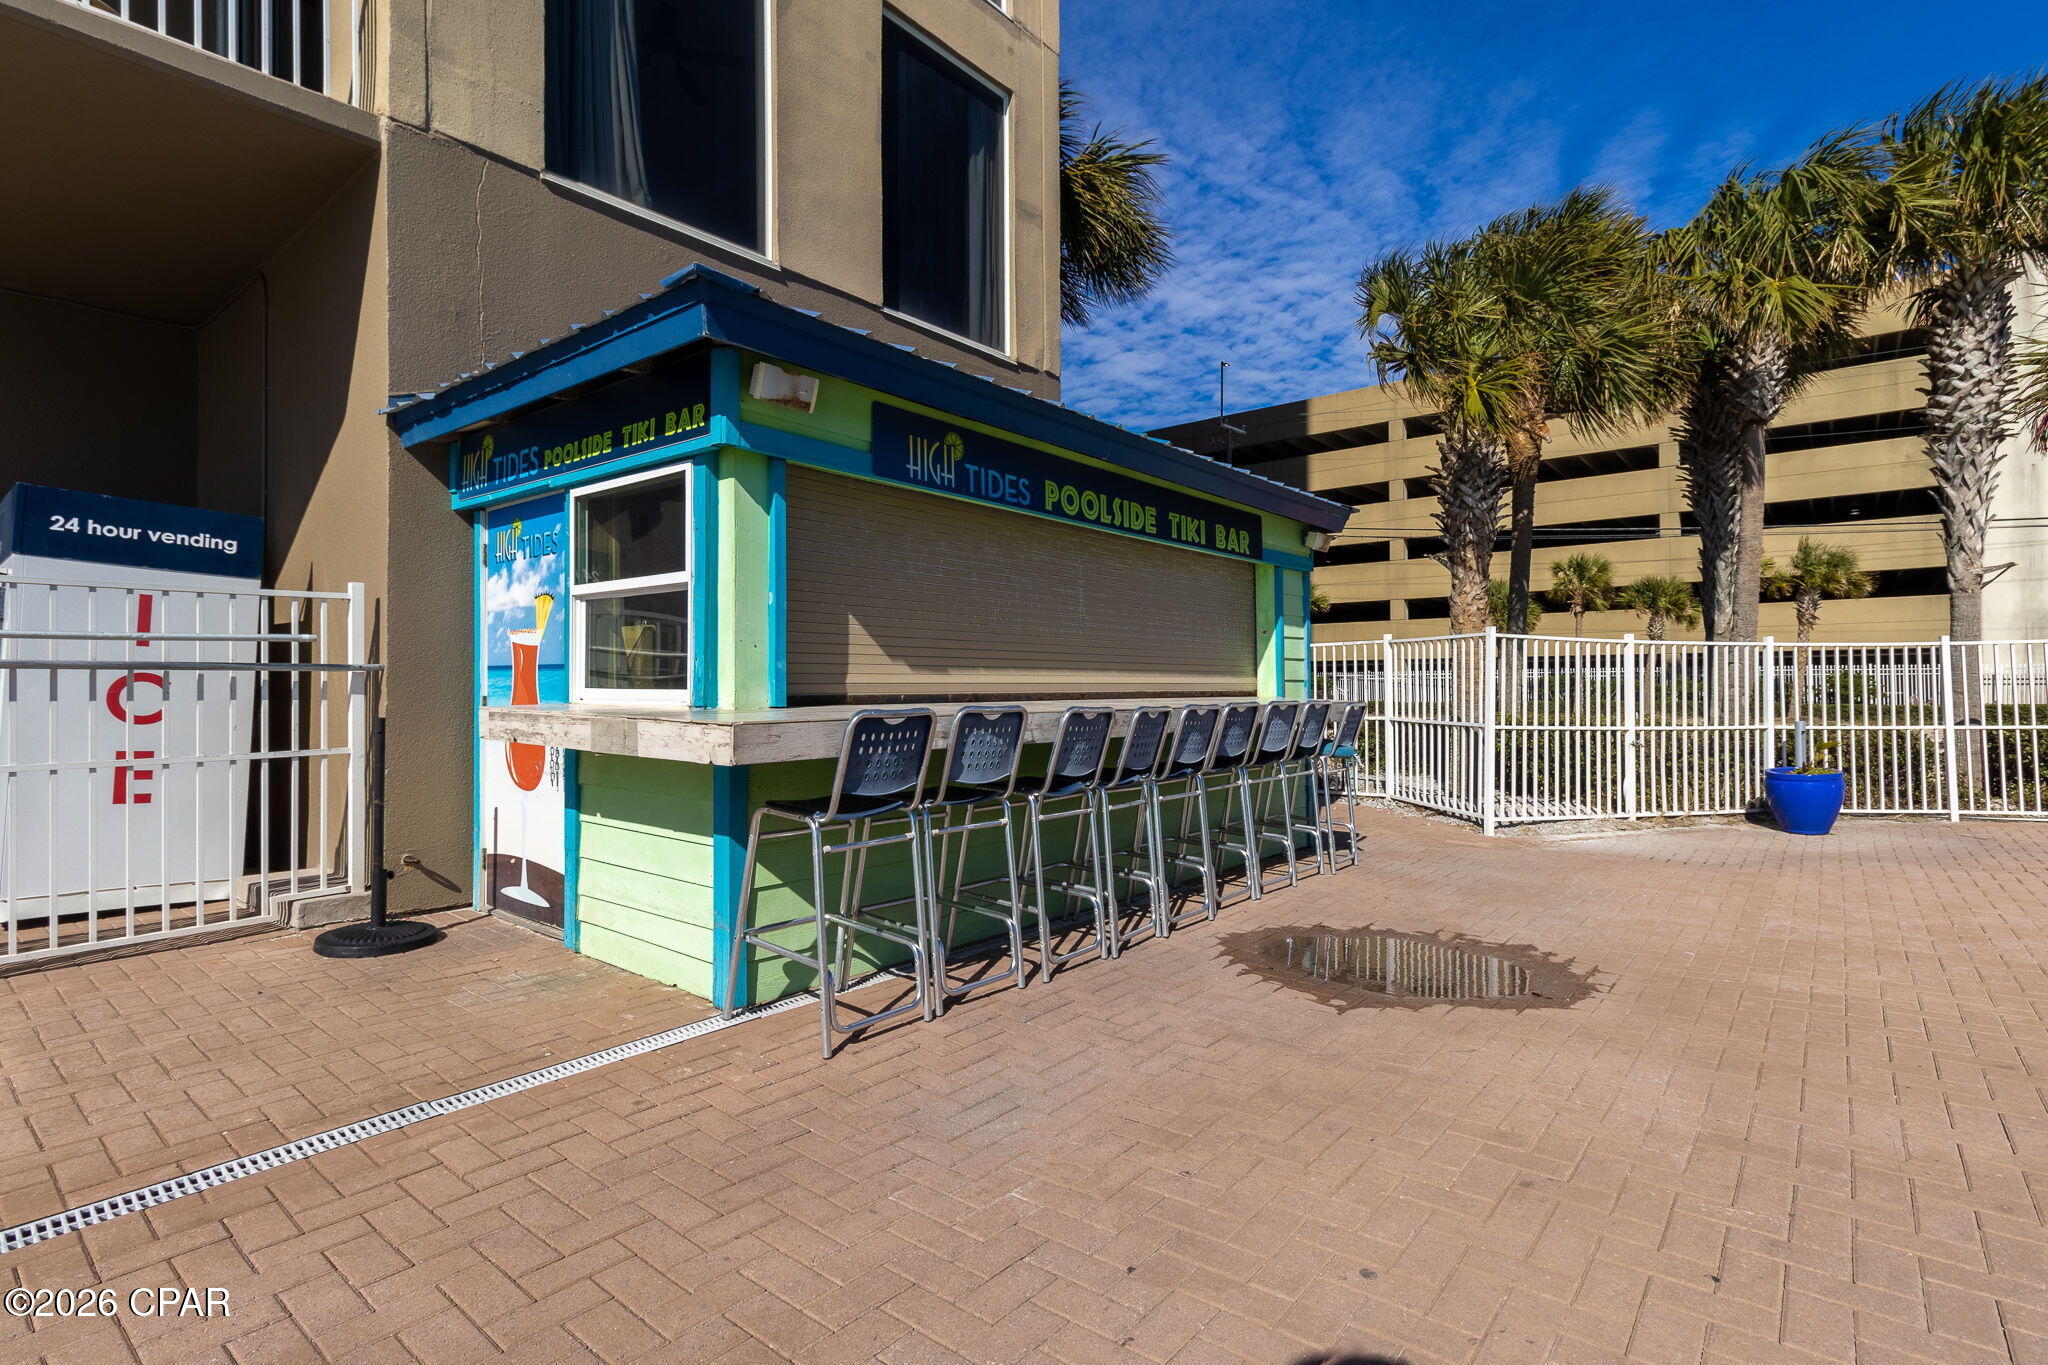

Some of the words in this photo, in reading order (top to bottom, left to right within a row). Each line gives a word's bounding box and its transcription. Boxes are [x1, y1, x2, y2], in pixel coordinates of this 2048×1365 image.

[461, 449, 488, 493] HIGH
[493, 446, 539, 485] TIDES
[543, 431, 613, 470] POOLSIDE
[621, 418, 656, 449] TIKI
[664, 403, 705, 437] BAR
[49, 515, 80, 534] 24
[87, 519, 142, 541] hour
[147, 528, 239, 554] vending
[905, 434, 956, 488] HIGH
[964, 463, 1031, 506] TIDES
[1044, 479, 1158, 534] POOLSIDE
[1168, 512, 1206, 545] TIKI
[1215, 523, 1250, 555] BAR
[494, 526, 518, 564] HIGH
[520, 529, 559, 558] TIDES
[105, 594, 172, 805] ICE
